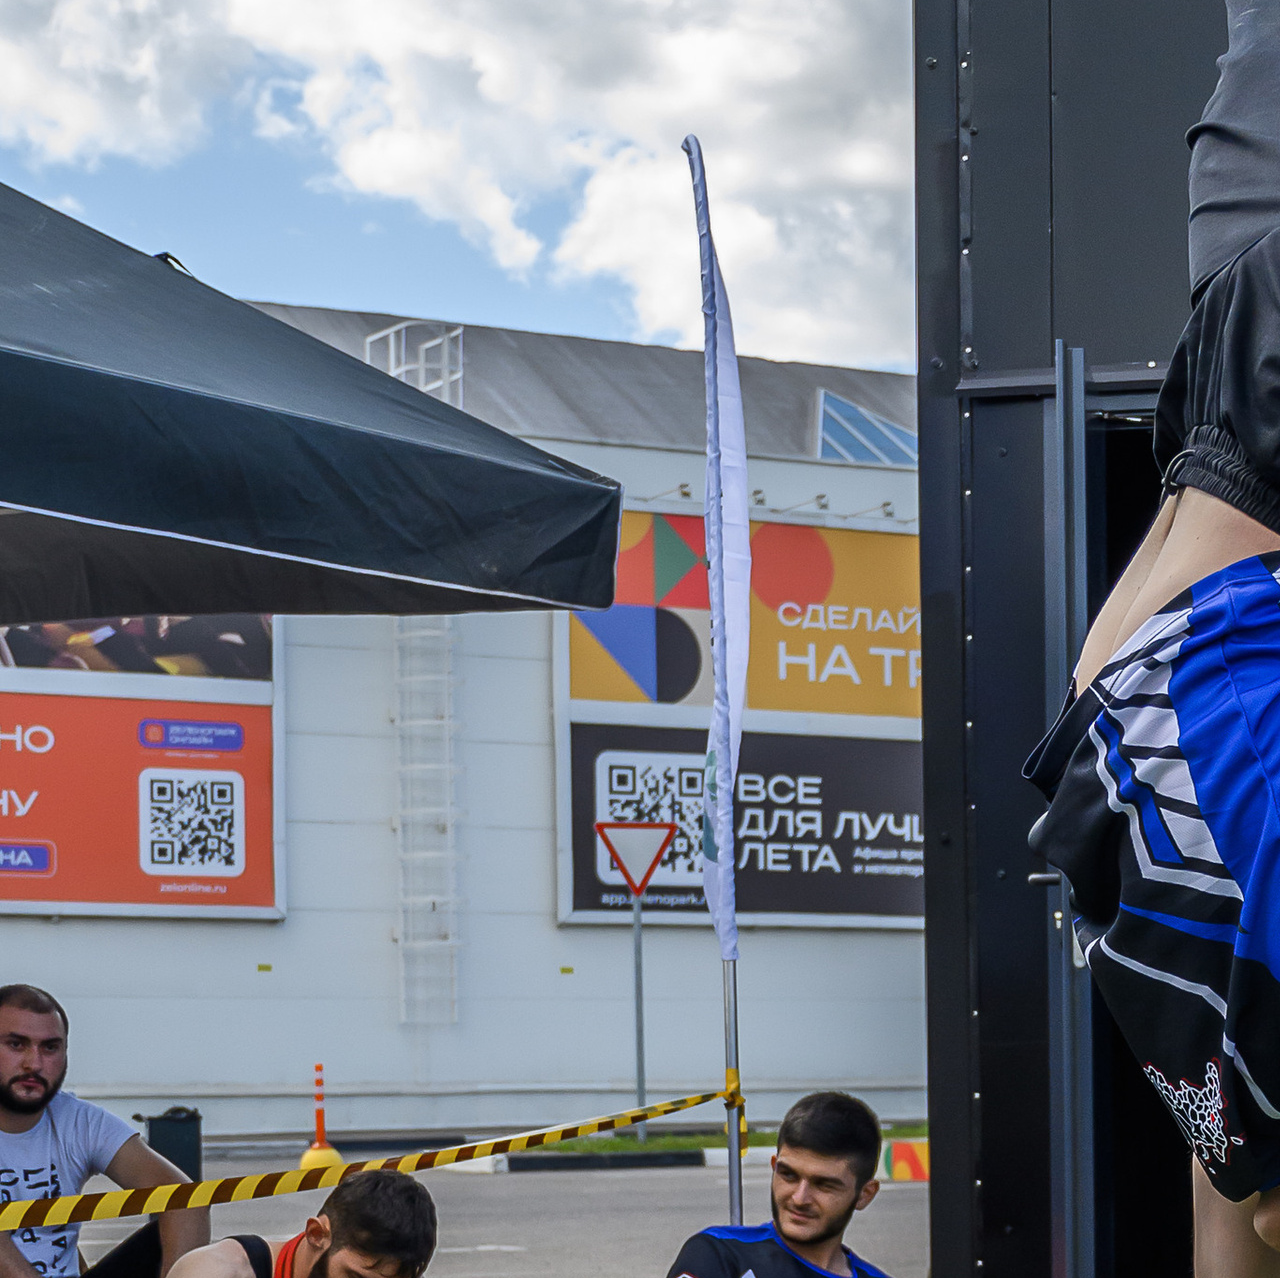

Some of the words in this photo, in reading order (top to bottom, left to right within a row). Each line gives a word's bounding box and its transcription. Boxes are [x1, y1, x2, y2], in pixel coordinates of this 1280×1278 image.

[777, 601, 921, 636] СДЕЛАЙ
[778, 640, 862, 685] НА
[738, 773, 822, 805] ВСЕ
[738, 808, 822, 840] ДЛЯ
[738, 842, 842, 873] ЛЕТА
